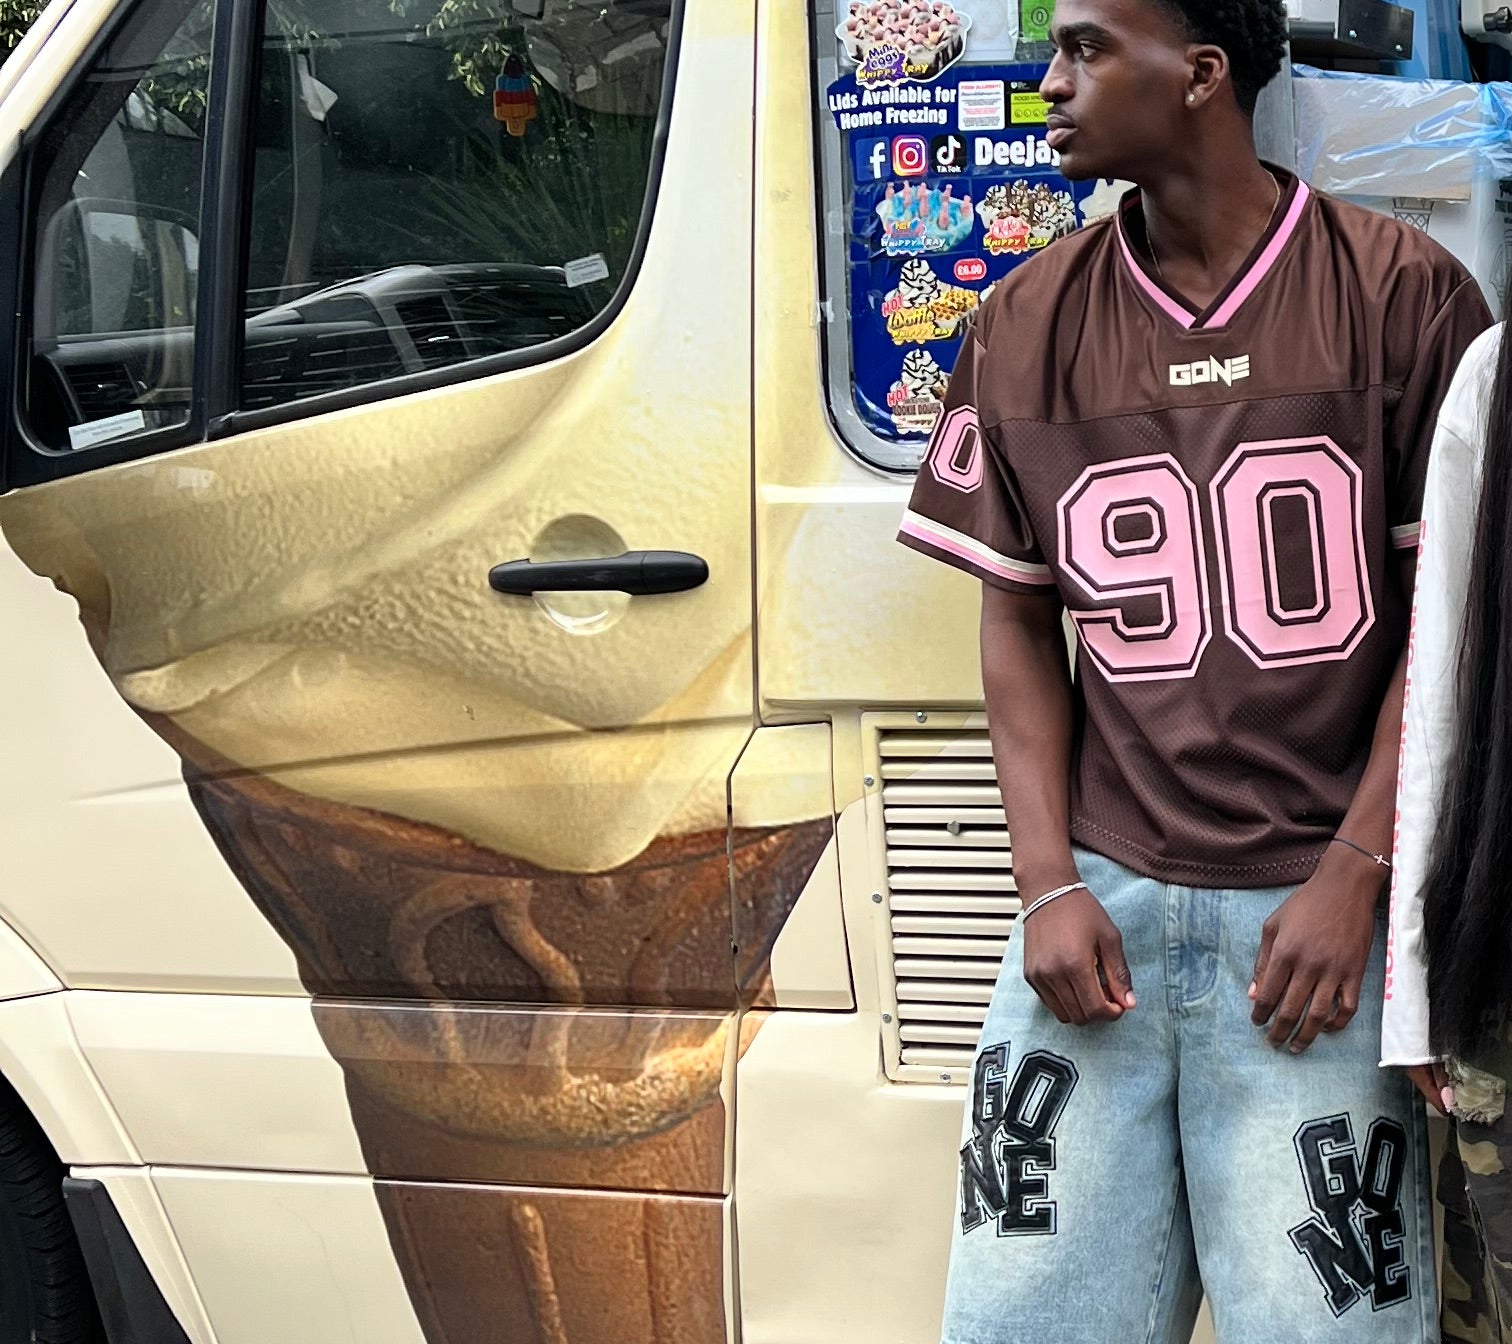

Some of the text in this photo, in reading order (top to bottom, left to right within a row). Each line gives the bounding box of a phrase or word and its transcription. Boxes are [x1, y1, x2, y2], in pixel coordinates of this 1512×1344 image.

[868, 44, 893, 58] Mini
[870, 50, 899, 69] eggs
[829, 86, 957, 112] Lids Available for
[840, 106, 948, 130] Home Freezing
[936, 165, 961, 174] TikTok
[881, 296, 904, 317] HOT
[1169, 354, 1250, 387] GONE
[1056, 435, 1376, 684] 90
